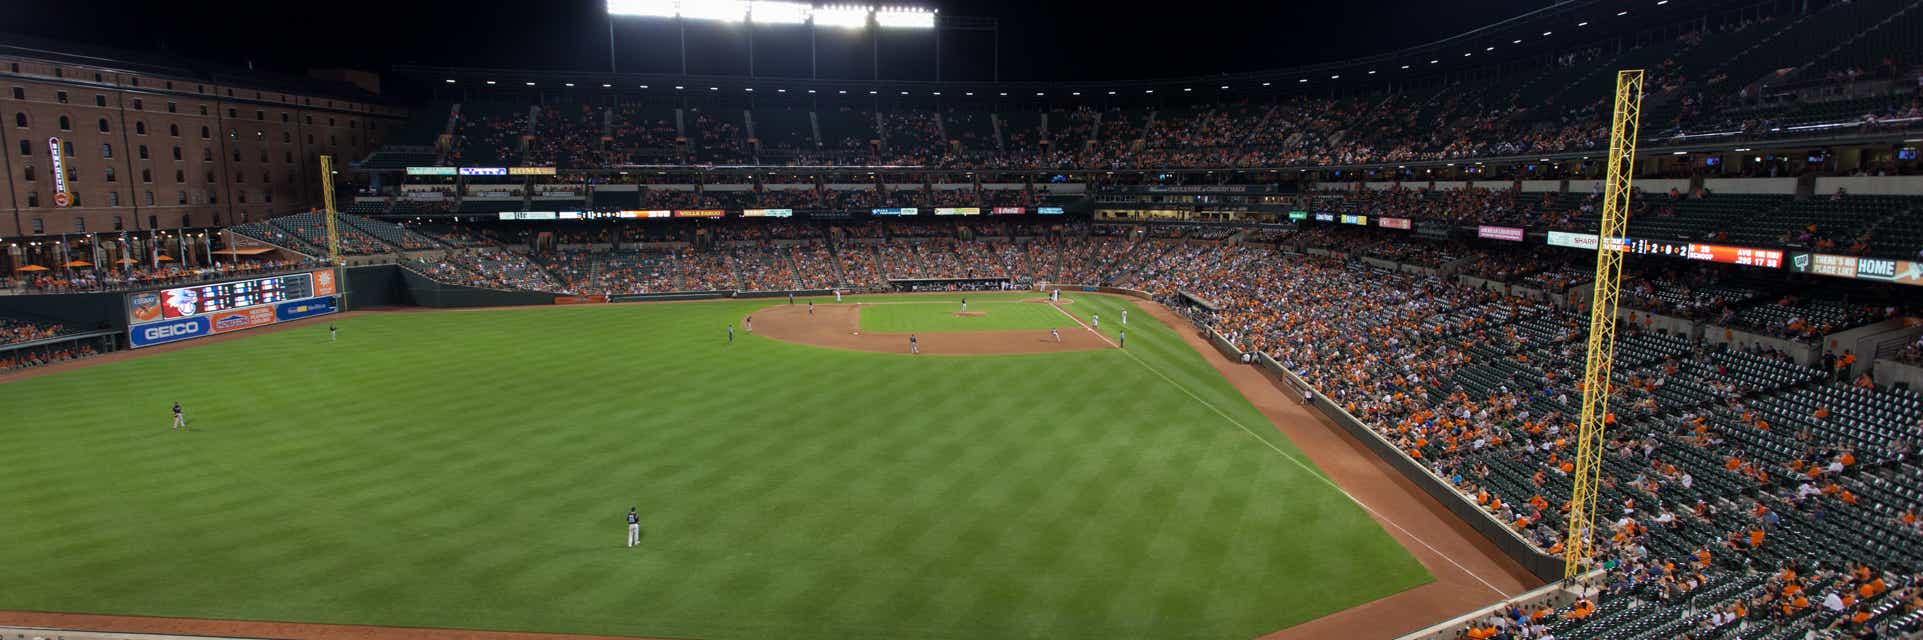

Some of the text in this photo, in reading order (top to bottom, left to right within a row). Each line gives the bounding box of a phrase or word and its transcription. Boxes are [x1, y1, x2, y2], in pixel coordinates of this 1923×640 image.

[1651, 243, 1658, 253] 2
[1680, 246, 1687, 256] 2
[1755, 258, 1764, 266] 17
[1858, 258, 1895, 274] HOME
[145, 321, 199, 340] GEICO
